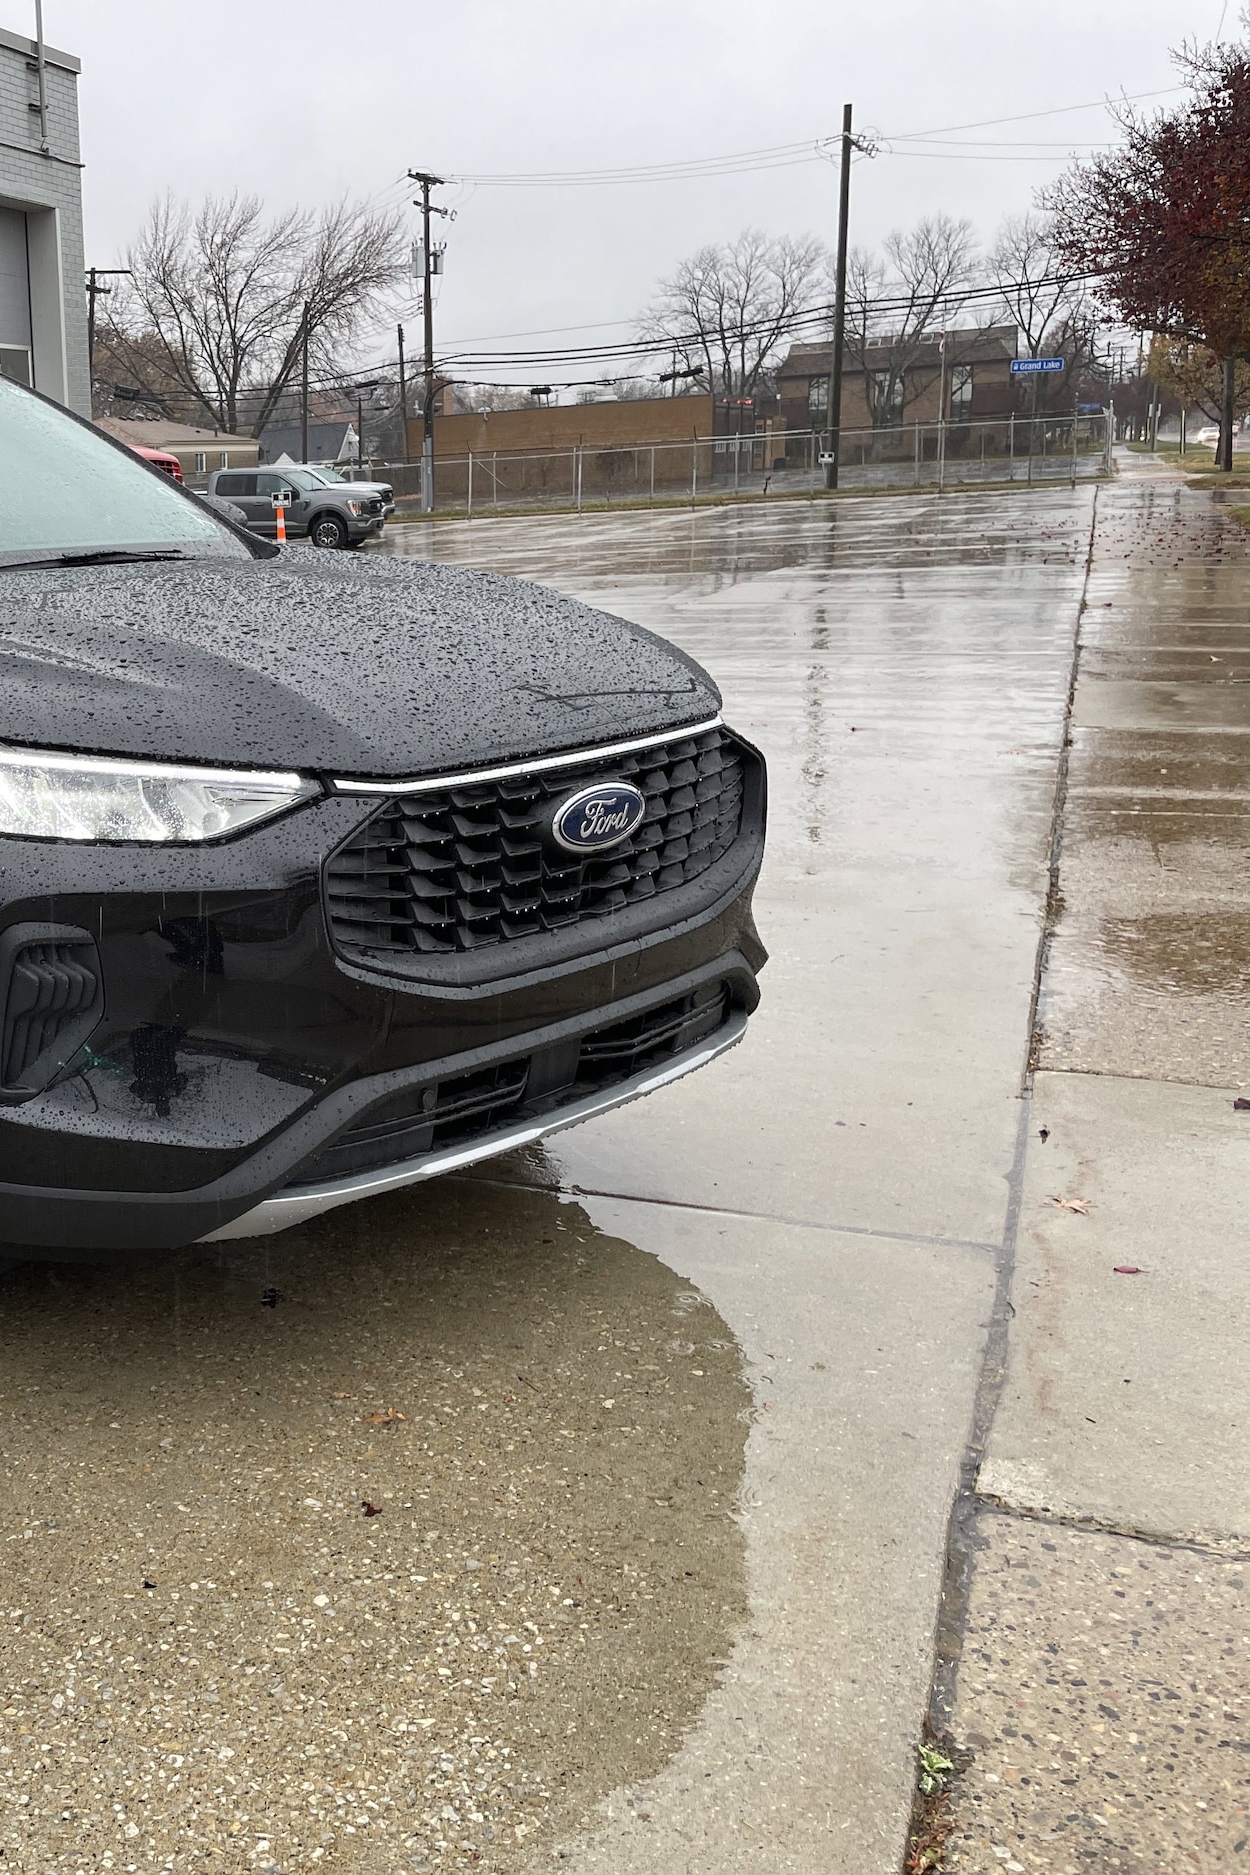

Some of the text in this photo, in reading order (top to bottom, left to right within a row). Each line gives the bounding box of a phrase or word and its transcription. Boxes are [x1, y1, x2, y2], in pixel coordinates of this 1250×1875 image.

[1020, 360, 1060, 371] Grand Lake
[580, 797, 630, 839] Ford
